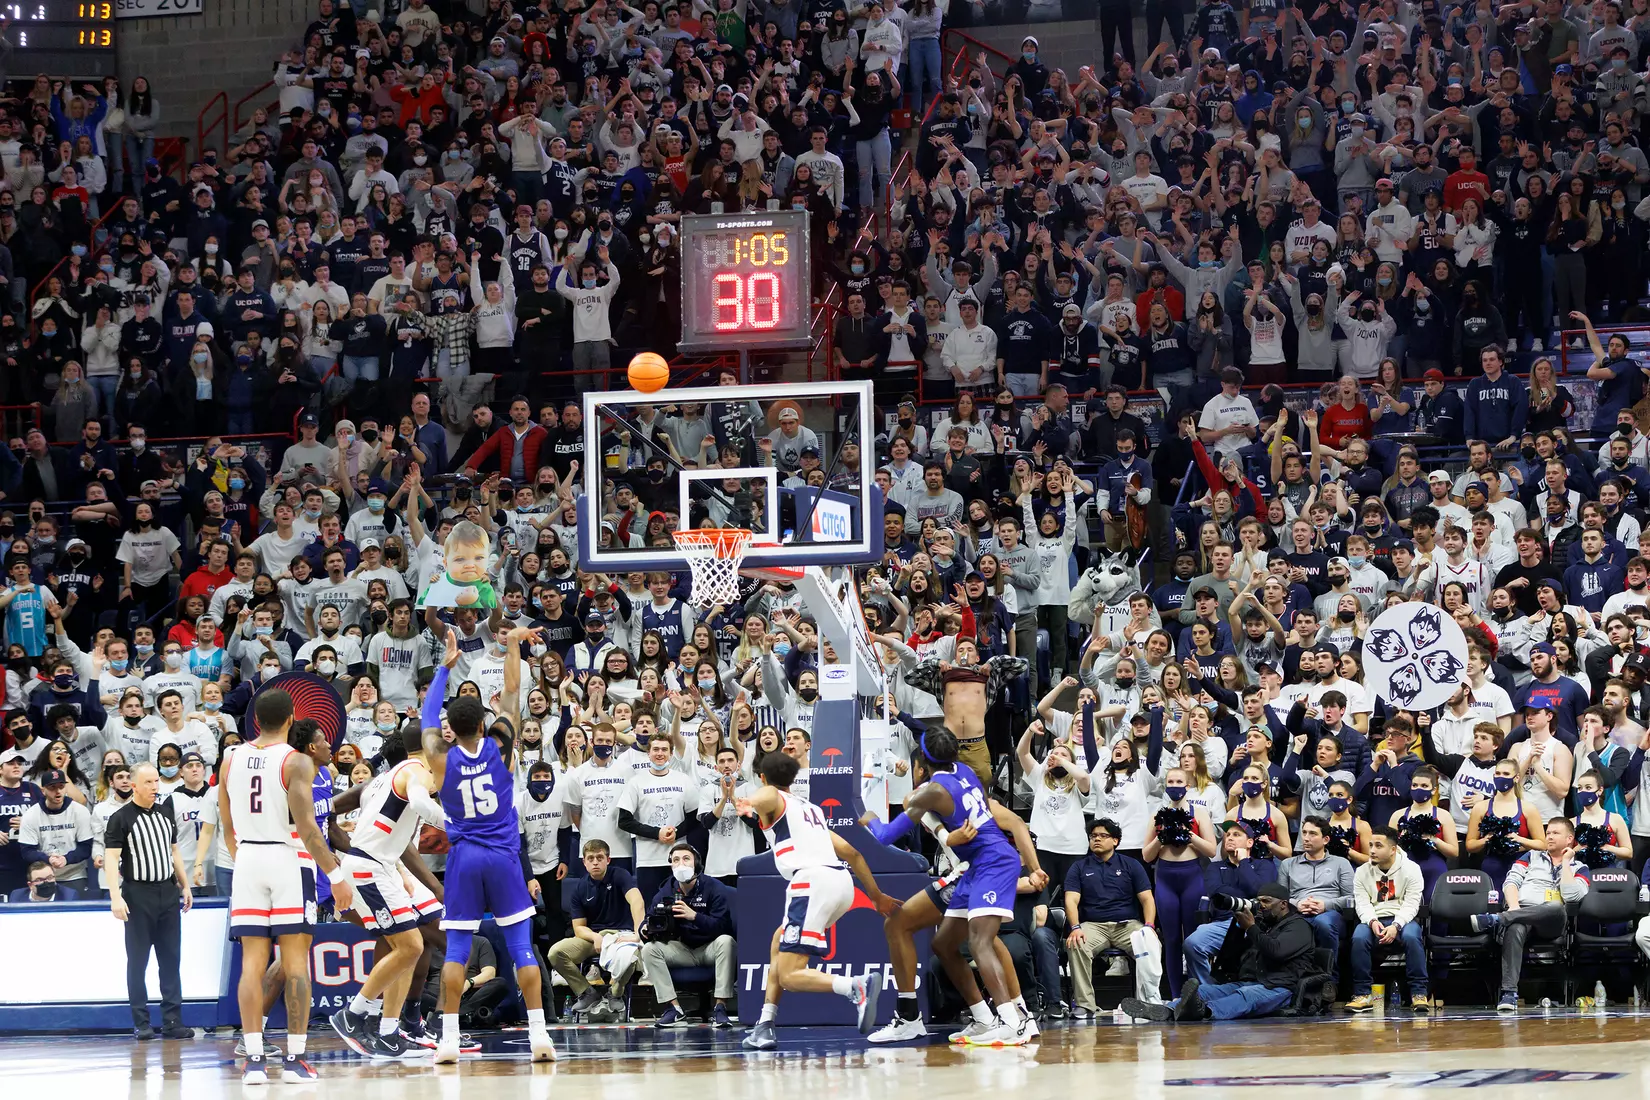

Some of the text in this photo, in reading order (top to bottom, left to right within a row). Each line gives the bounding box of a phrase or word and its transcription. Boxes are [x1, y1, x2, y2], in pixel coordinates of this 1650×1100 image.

[118, 0, 144, 9] SEC
[80, 4, 110, 19] 113
[80, 30, 110, 46] 113
[1600, 38, 1624, 46] UCONN
[562, 182, 570, 195] 2
[430, 224, 444, 235] 34
[735, 234, 788, 265] 1:05
[518, 257, 529, 270] 32
[577, 296, 601, 305] UCONN
[714, 273, 778, 328] 30
[1464, 317, 1486, 325] UCONN
[1357, 328, 1378, 338] UCONN
[1152, 339, 1178, 352] UCONN
[1480, 388, 1509, 400] UCONN
[557, 443, 583, 452] PARIS
[822, 512, 844, 539] CITGO
[59, 574, 90, 584] UCONN
[12, 600, 41, 609] HORNETS
[1103, 606, 1129, 616] CONN
[22, 612, 33, 628] 5
[1109, 617, 1113, 631] 1
[383, 648, 412, 663] UCONN
[720, 642, 730, 657] 15
[191, 666, 219, 674] HORNETS
[248, 757, 266, 770] COLE
[461, 762, 487, 776] HARRIS
[810, 766, 853, 775] TRAVELERS
[1459, 774, 1496, 792] UCONN
[250, 776, 262, 813] 2
[457, 774, 498, 818] 15
[804, 808, 825, 830] 44
